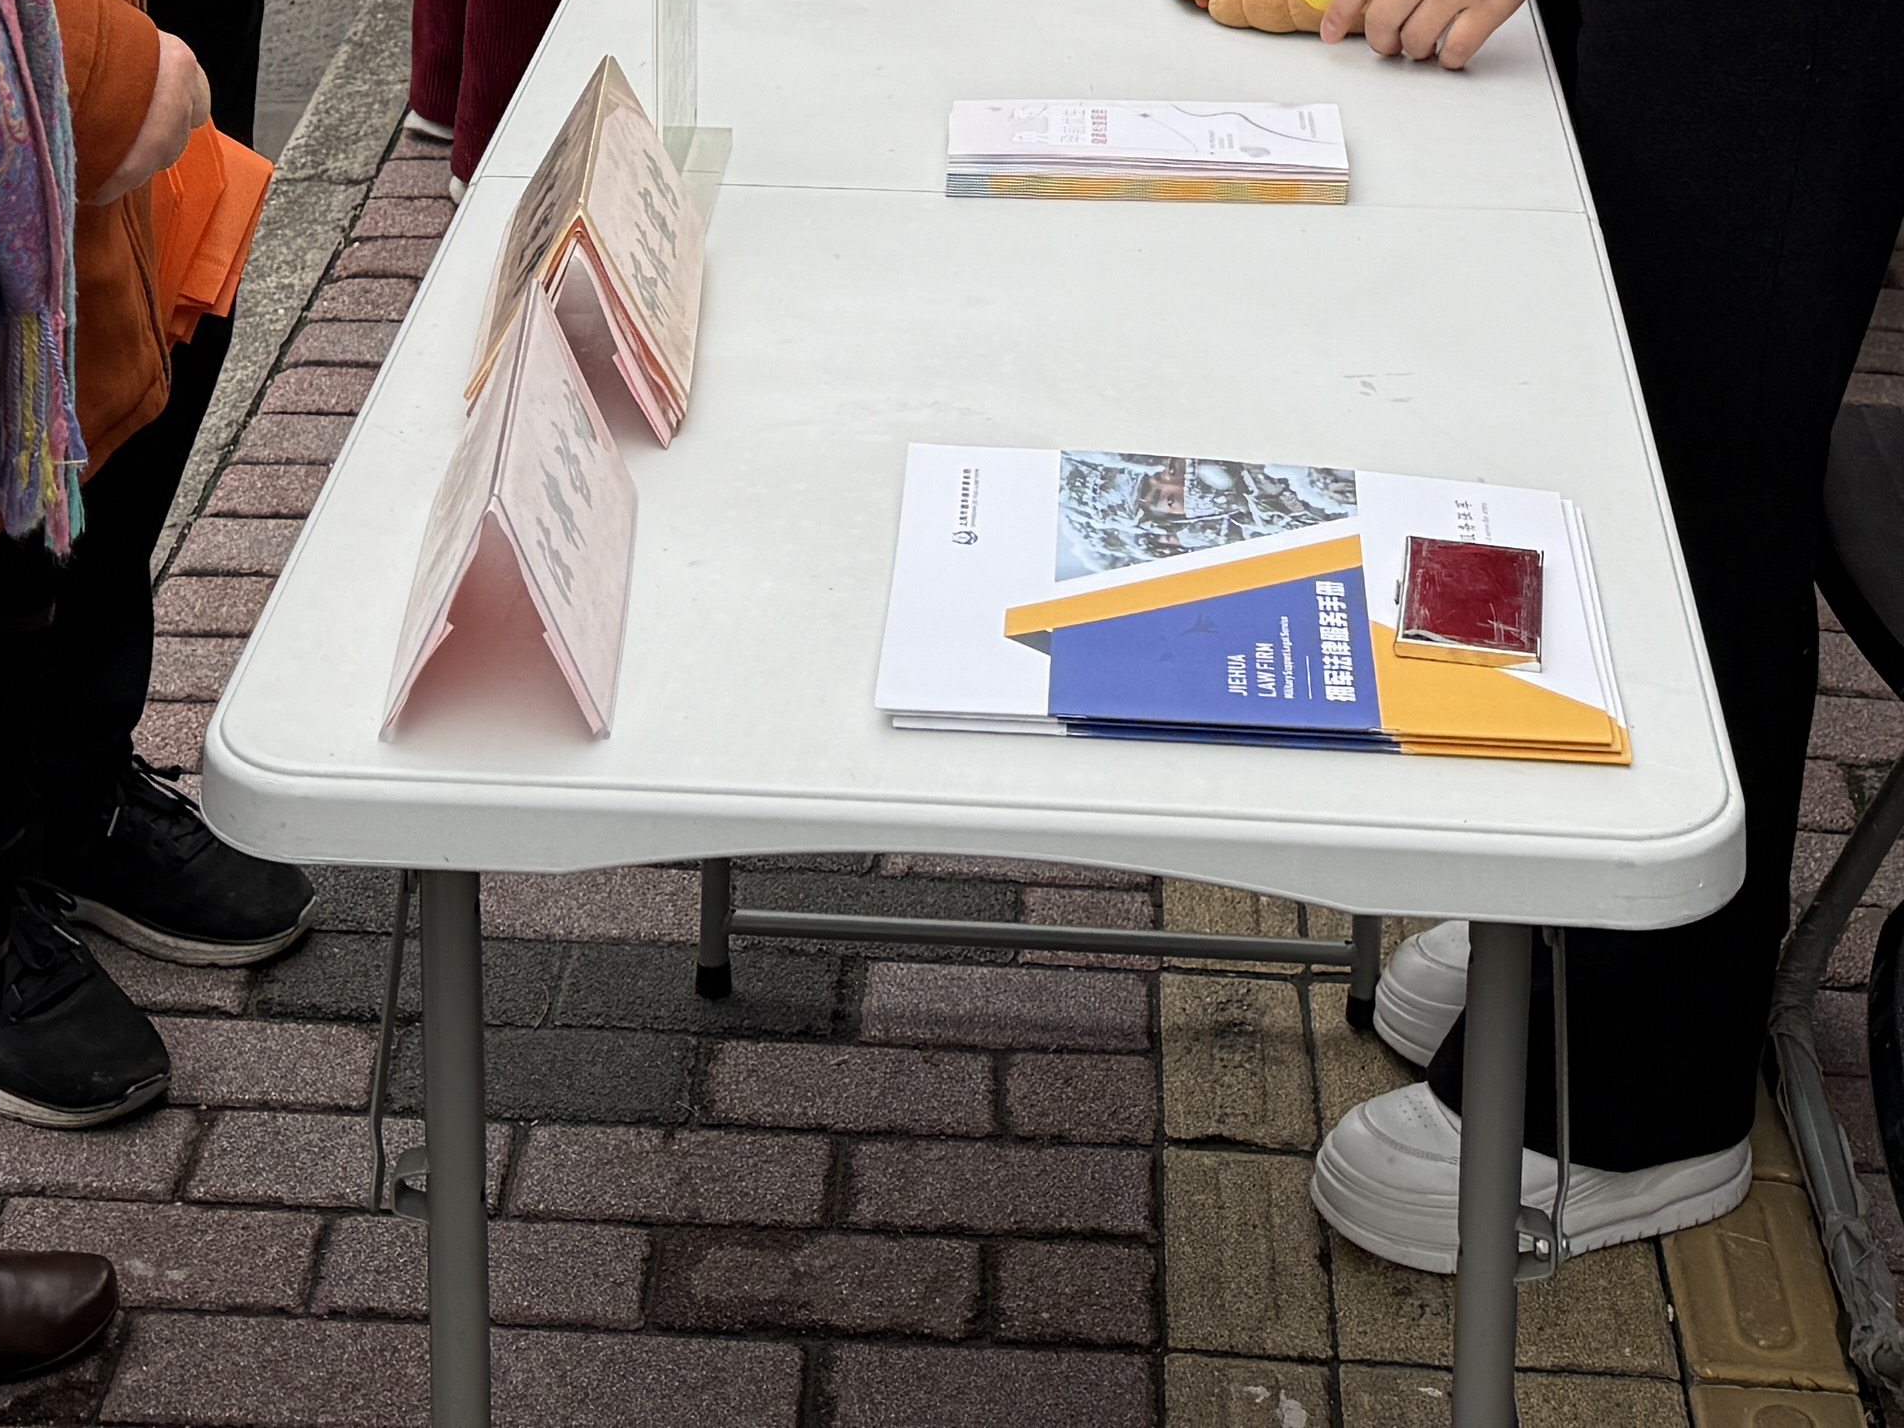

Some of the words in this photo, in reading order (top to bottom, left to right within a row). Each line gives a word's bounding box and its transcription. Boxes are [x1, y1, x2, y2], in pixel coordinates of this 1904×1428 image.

[1255, 642, 1275, 670] FIRM
[1315, 580, 1356, 702] 拥军法律服务手册
[1227, 654, 1248, 696] JIEHUA
[1257, 673, 1277, 698] LAW
